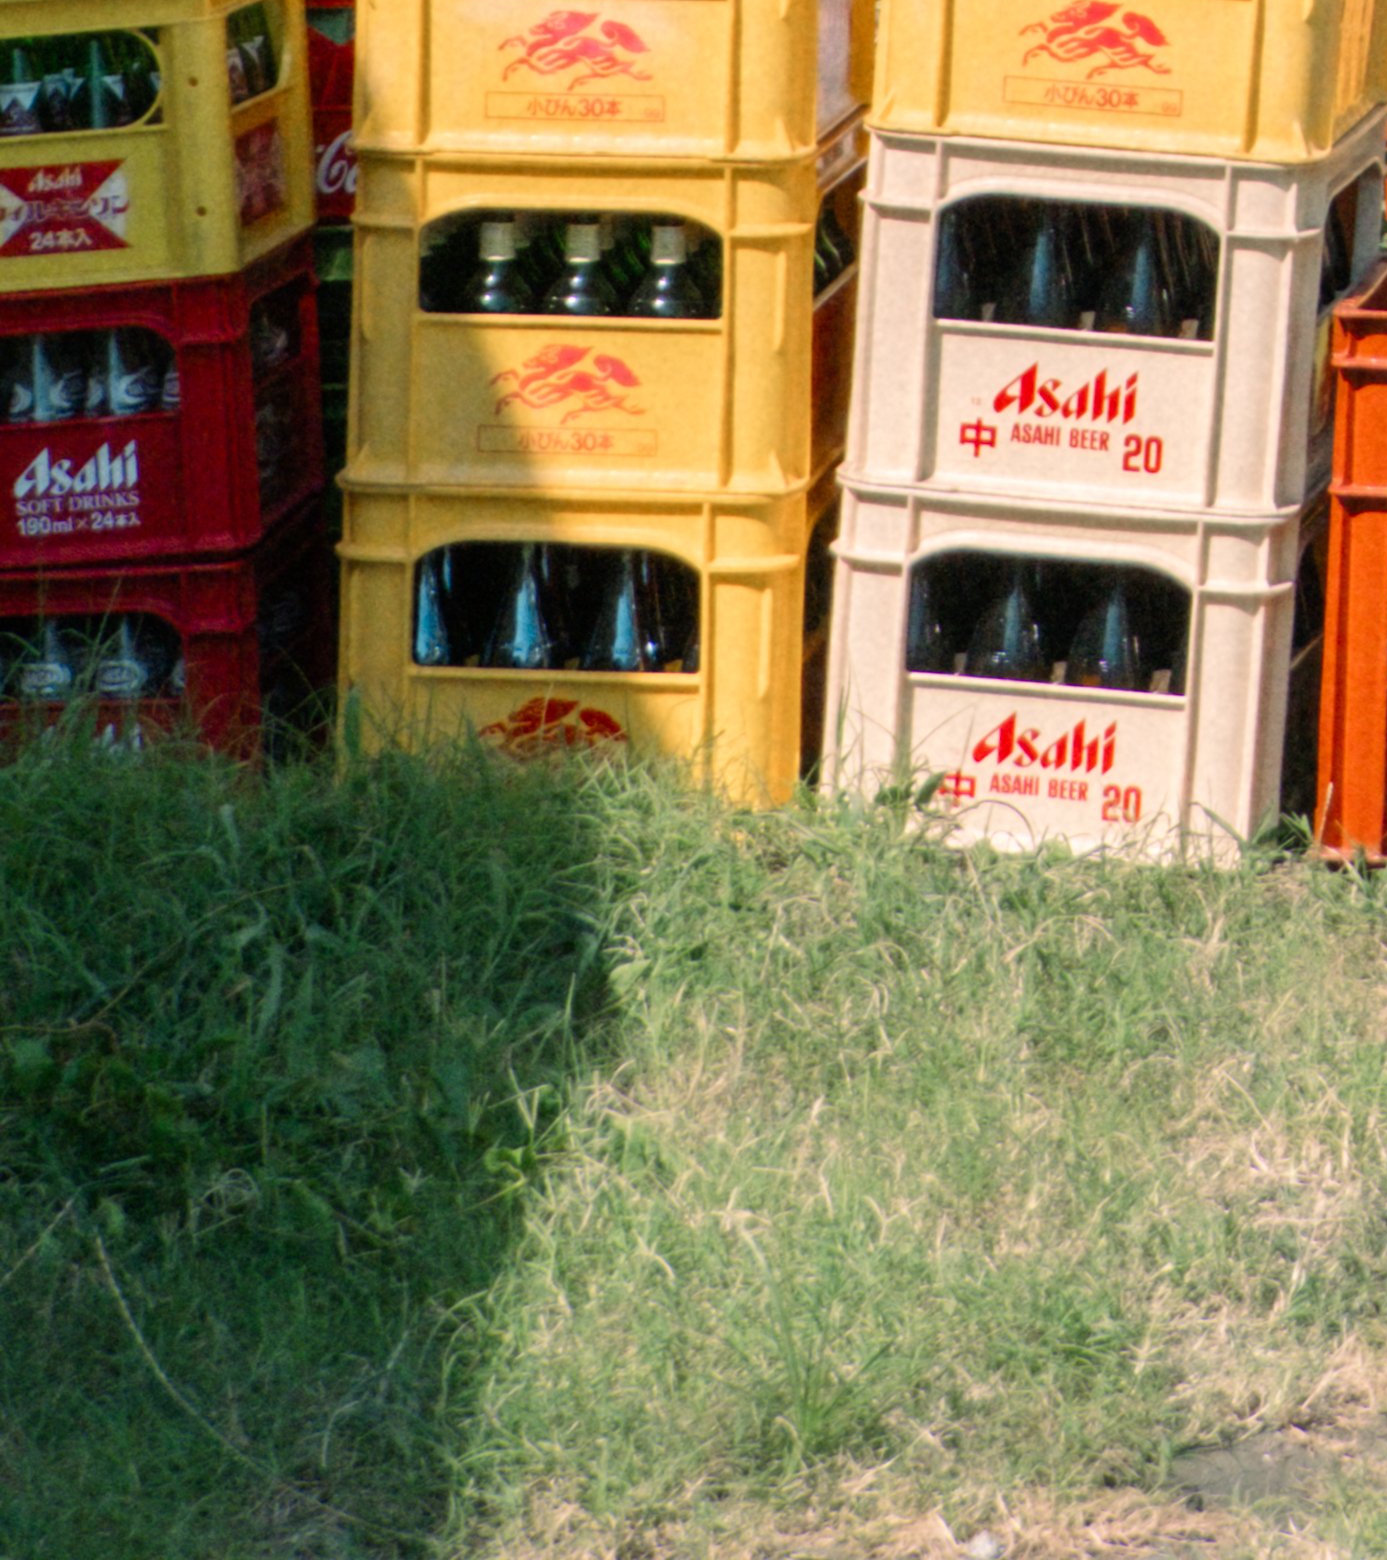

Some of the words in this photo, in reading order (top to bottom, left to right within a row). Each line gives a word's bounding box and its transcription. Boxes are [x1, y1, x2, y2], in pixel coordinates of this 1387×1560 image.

[28, 166, 82, 193] Asahi
[30, 228, 92, 250] 24本入
[993, 361, 1139, 425] Asahi
[13, 439, 138, 498] Asahi
[959, 417, 997, 458] 中
[1010, 422, 1061, 446] ASAHI
[1069, 427, 1110, 451] BEER
[1122, 433, 1164, 474] 20
[16, 496, 63, 516] SOFT
[68, 491, 140, 512] DRINKS
[972, 710, 1117, 776] Asahi
[938, 770, 976, 808] 中
[989, 773, 1040, 796] ASAHI
[1048, 778, 1089, 801] BEER
[1101, 784, 1142, 822] 20
